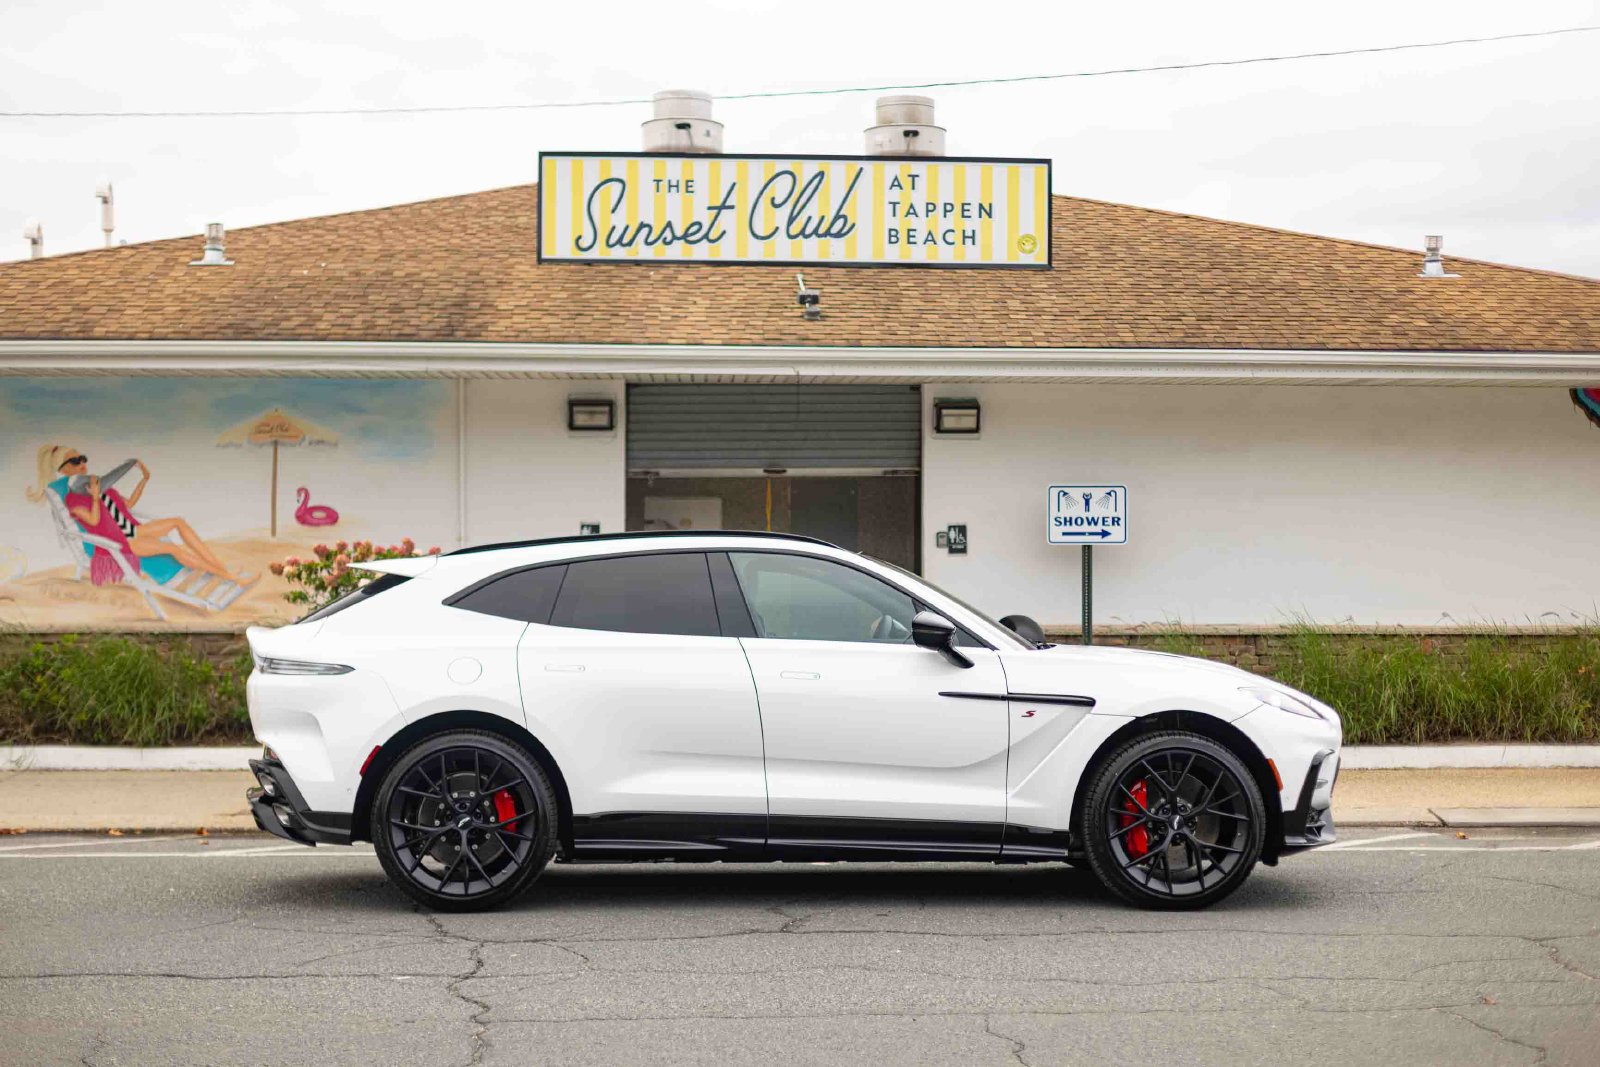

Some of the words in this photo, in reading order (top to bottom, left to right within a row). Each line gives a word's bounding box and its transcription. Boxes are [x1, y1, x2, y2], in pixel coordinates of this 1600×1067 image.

[652, 178, 695, 194] THE
[889, 174, 920, 191] AT
[574, 177, 738, 253] Sunset
[748, 166, 864, 241] Club
[888, 201, 993, 219] TAPPEN
[888, 227, 976, 246] BEACH
[1053, 516, 1122, 527] SHOWER
